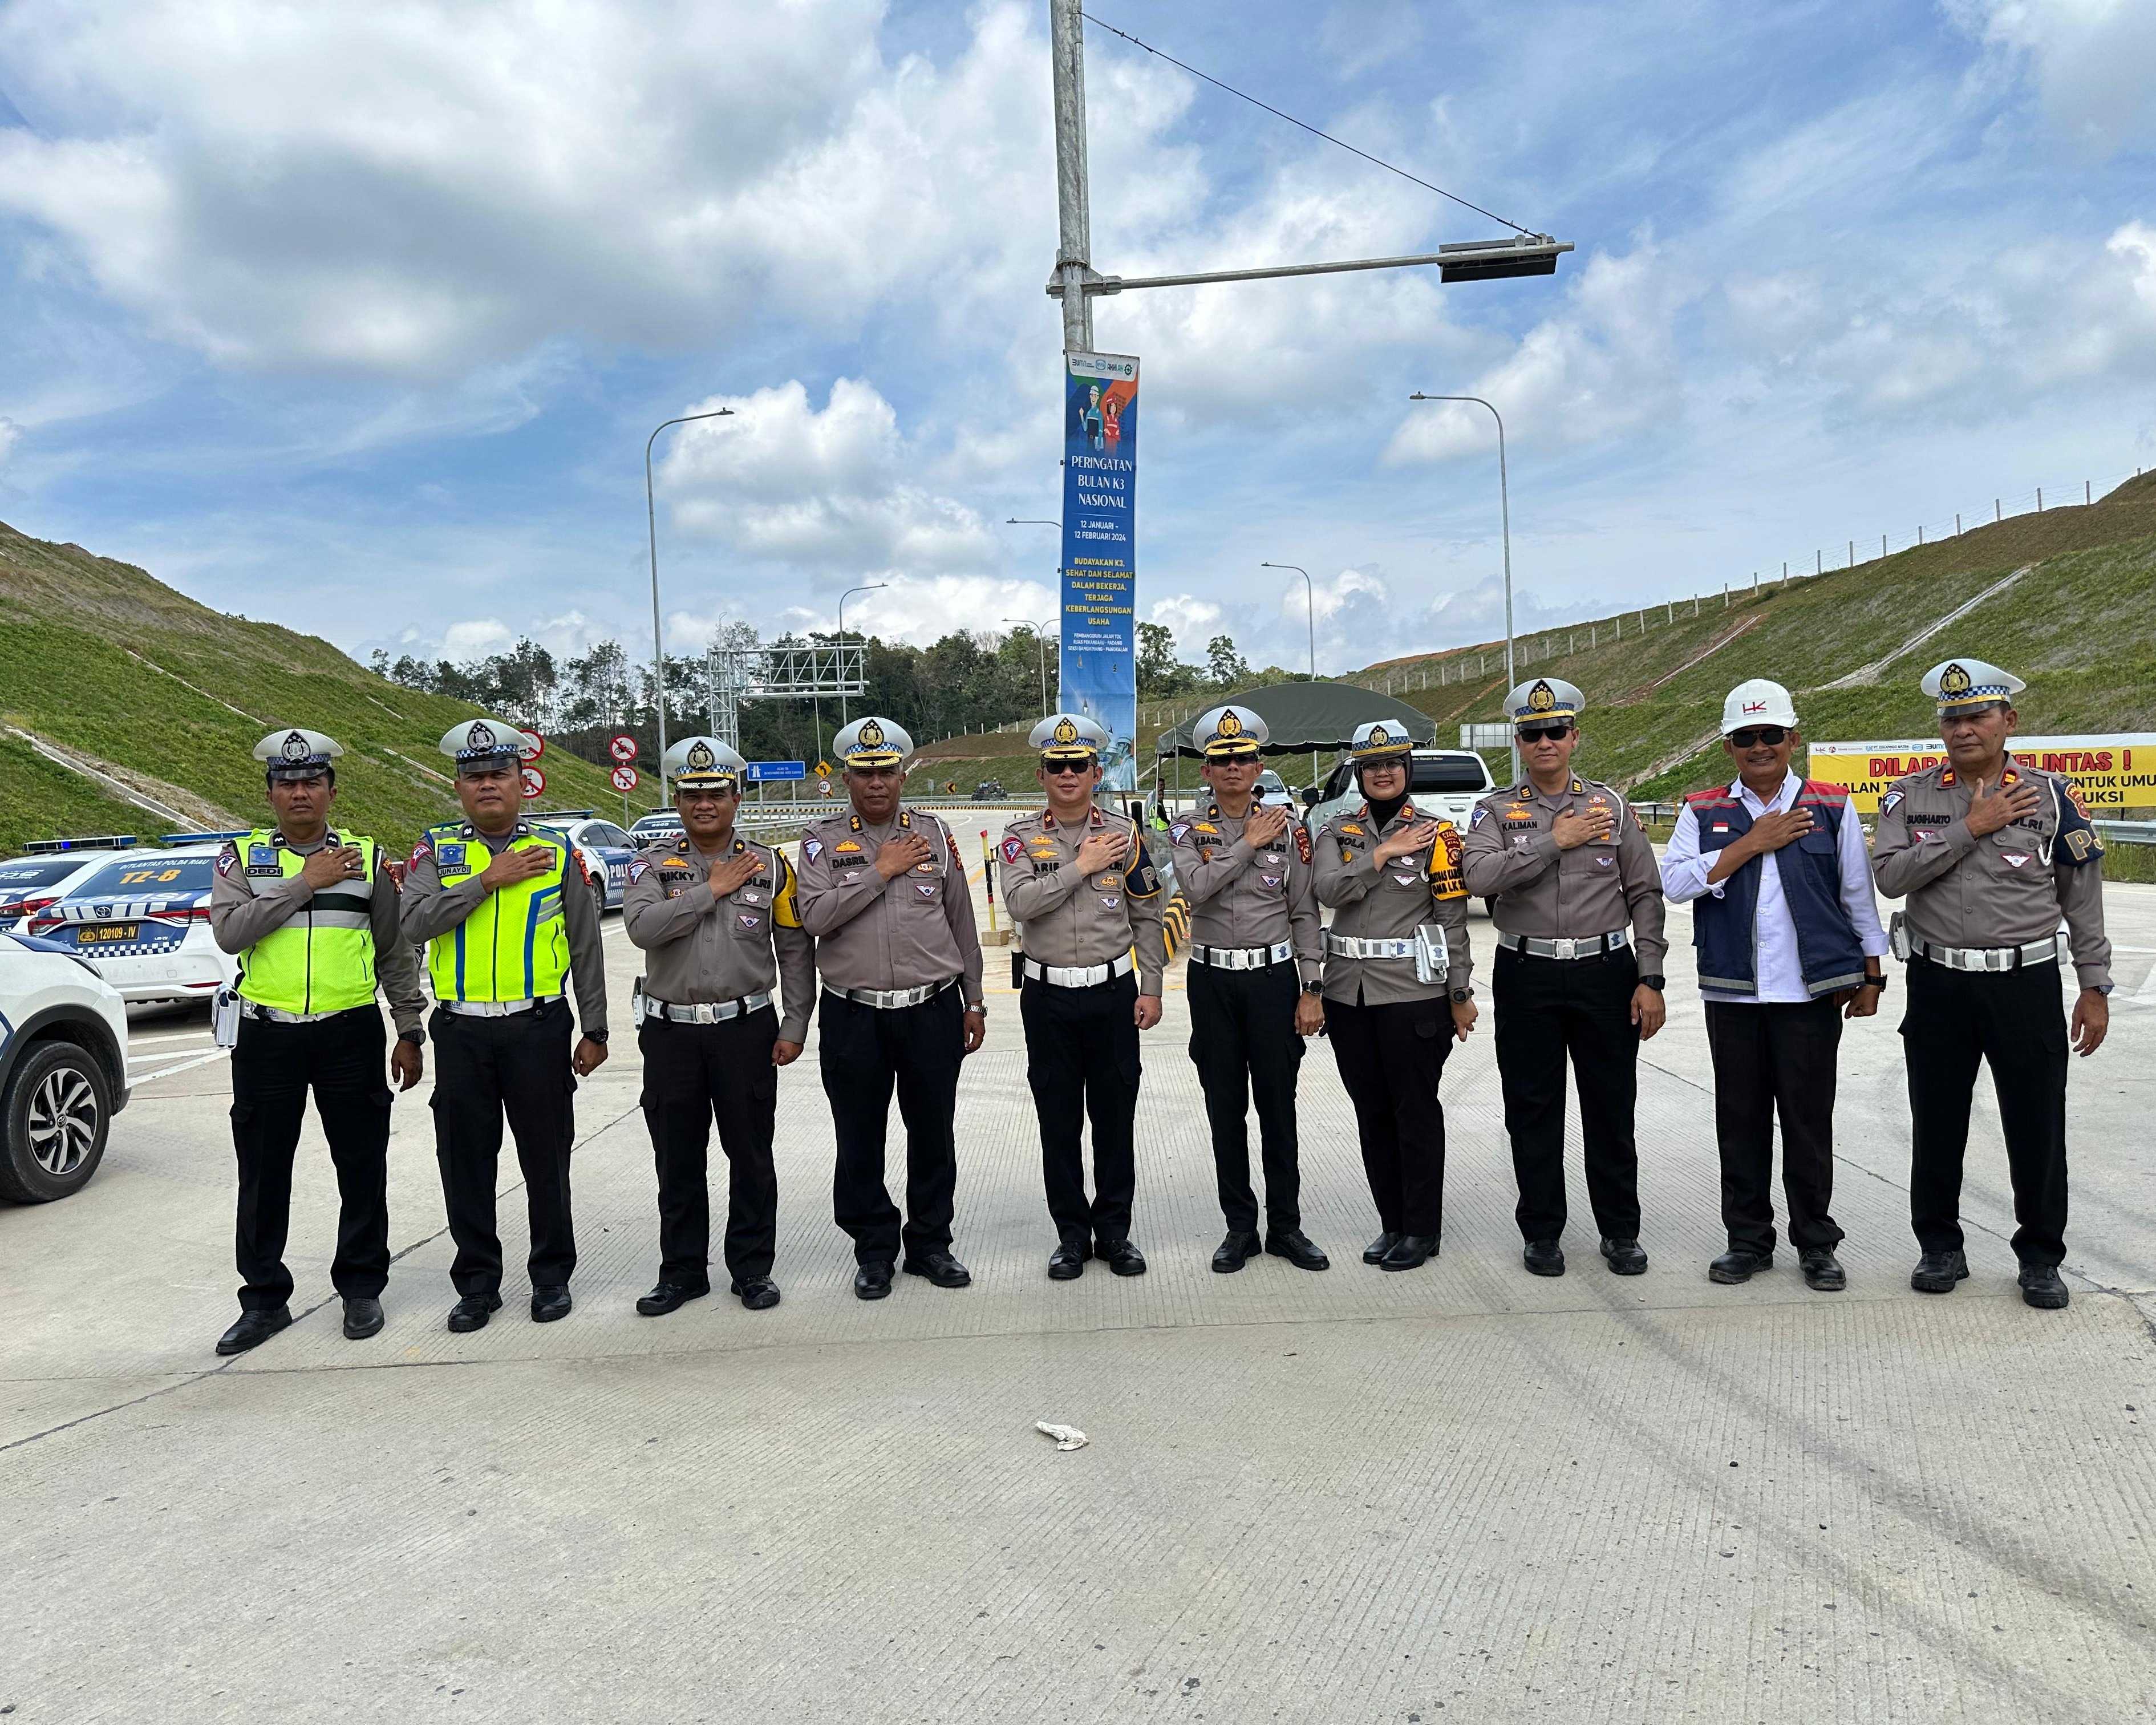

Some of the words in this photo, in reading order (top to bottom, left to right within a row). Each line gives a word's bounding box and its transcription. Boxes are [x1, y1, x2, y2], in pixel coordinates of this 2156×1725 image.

[1071, 455, 1132, 472] PERINGATAN
[1078, 475, 1109, 488] BULAN
[1113, 477, 1124, 490] K3
[1078, 493, 1126, 508] NASIONAL
[1088, 521, 1114, 530] JANUARI
[1082, 532, 1111, 541] FEBRUARI
[1112, 533, 1126, 541] 2024
[1074, 557, 1113, 566] BUDAYAKAN
[1065, 569, 1087, 577] SEHAT
[1072, 581, 1095, 590] DALAM
[1096, 582, 1127, 591] BEKERJA,
[1085, 593, 1113, 602] TERJAGA
[1065, 605, 1132, 614] KEBERLANGSUNGAN
[1088, 617, 1110, 626] USAHA
[1742, 700, 1766, 713] HK
[1870, 756, 1950, 777] DILAR
[2011, 752, 2113, 772] ELINTAS
[1836, 782, 1879, 794] ALAN
[2070, 776, 2117, 788] NTUK
[2121, 775, 2156, 787] UMU
[1907, 814, 1951, 824] SUGIHARTO
[2009, 817, 2043, 831] OLRI
[1502, 821, 1537, 832] KALIMAN
[1263, 841, 1286, 853] OLRI
[119, 861, 163, 870] DITLANTAS
[832, 856, 868, 868] DASRIL
[439, 866, 469, 876] JUNAYDI
[610, 864, 628, 878] POLI
[659, 871, 695, 883] RIKKY
[744, 877, 771, 889] OLRI
[62, 892, 193, 905] POLISI
[99, 926, 123, 940] 120109
[128, 926, 136, 937] IV
